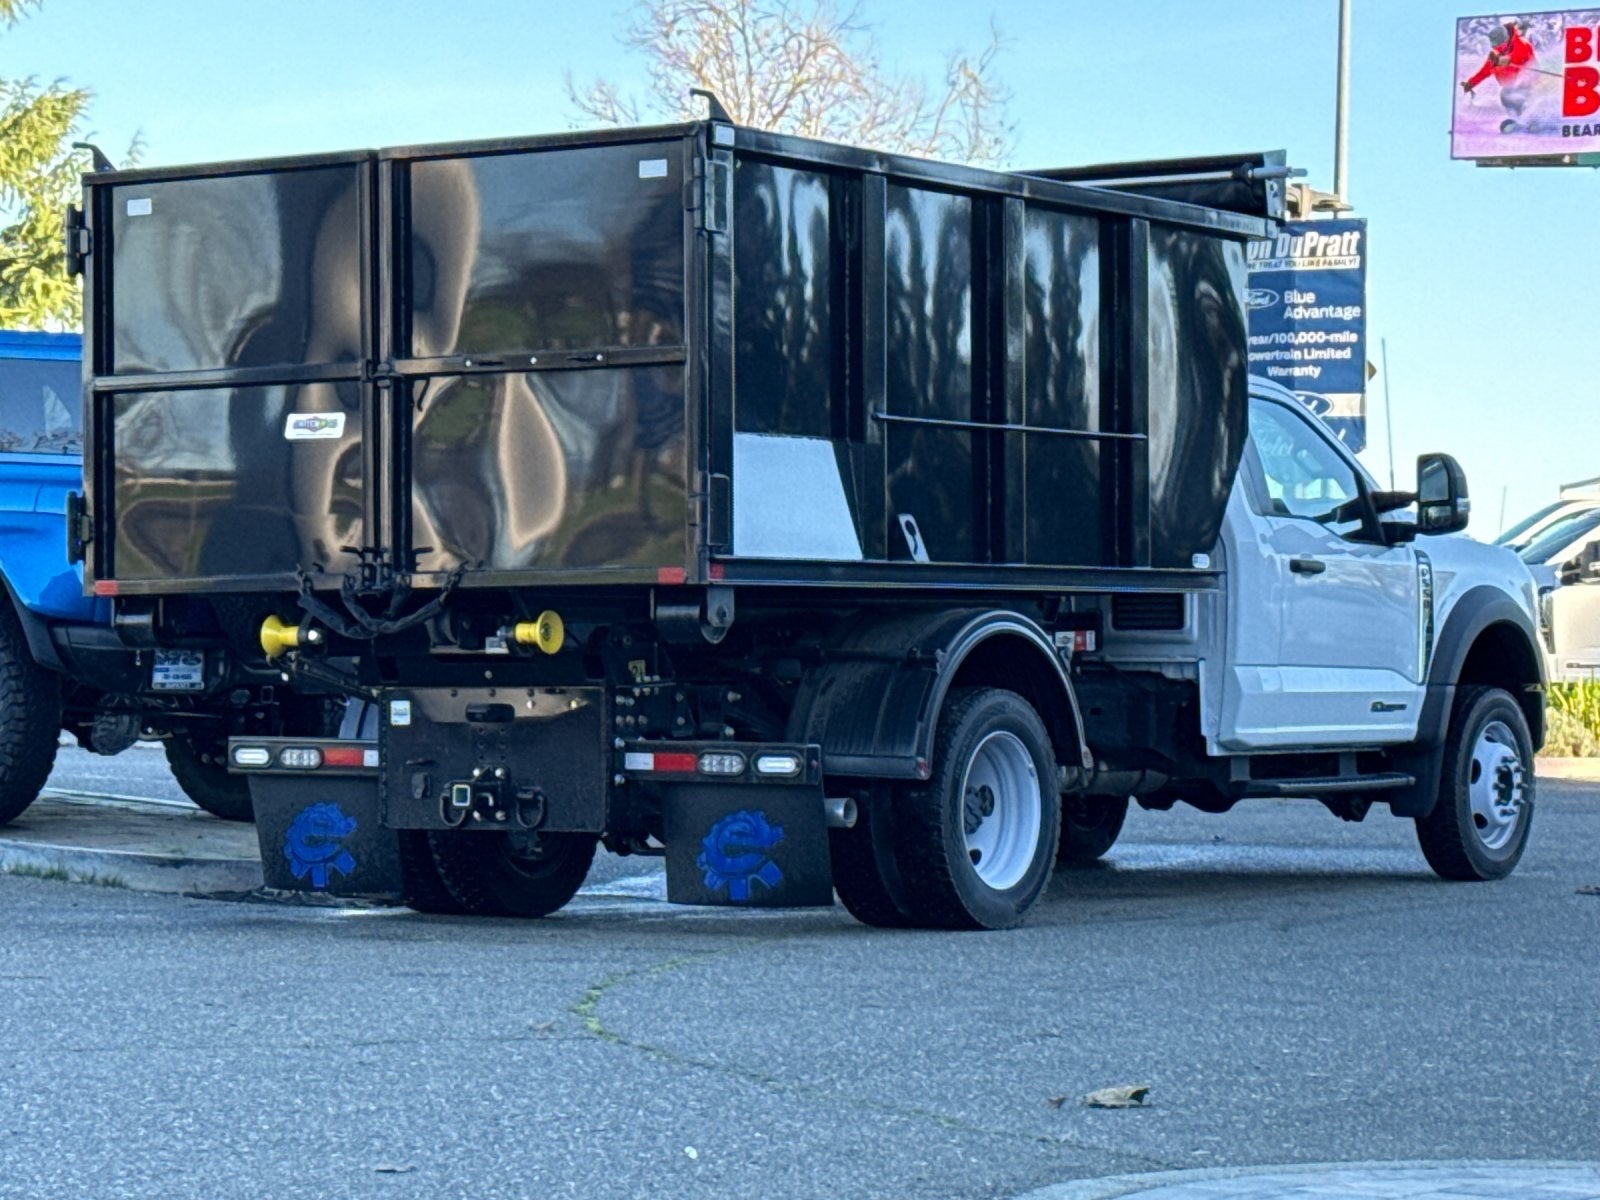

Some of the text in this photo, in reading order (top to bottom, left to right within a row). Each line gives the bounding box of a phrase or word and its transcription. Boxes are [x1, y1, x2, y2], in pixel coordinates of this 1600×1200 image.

[1565, 26, 1600, 64] B
[1276, 231, 1360, 256] DuPratt
[1284, 289, 1316, 304] Blue
[1283, 305, 1361, 320] Advantage
[1304, 347, 1352, 360] Limited
[1266, 365, 1322, 379] Warranty
